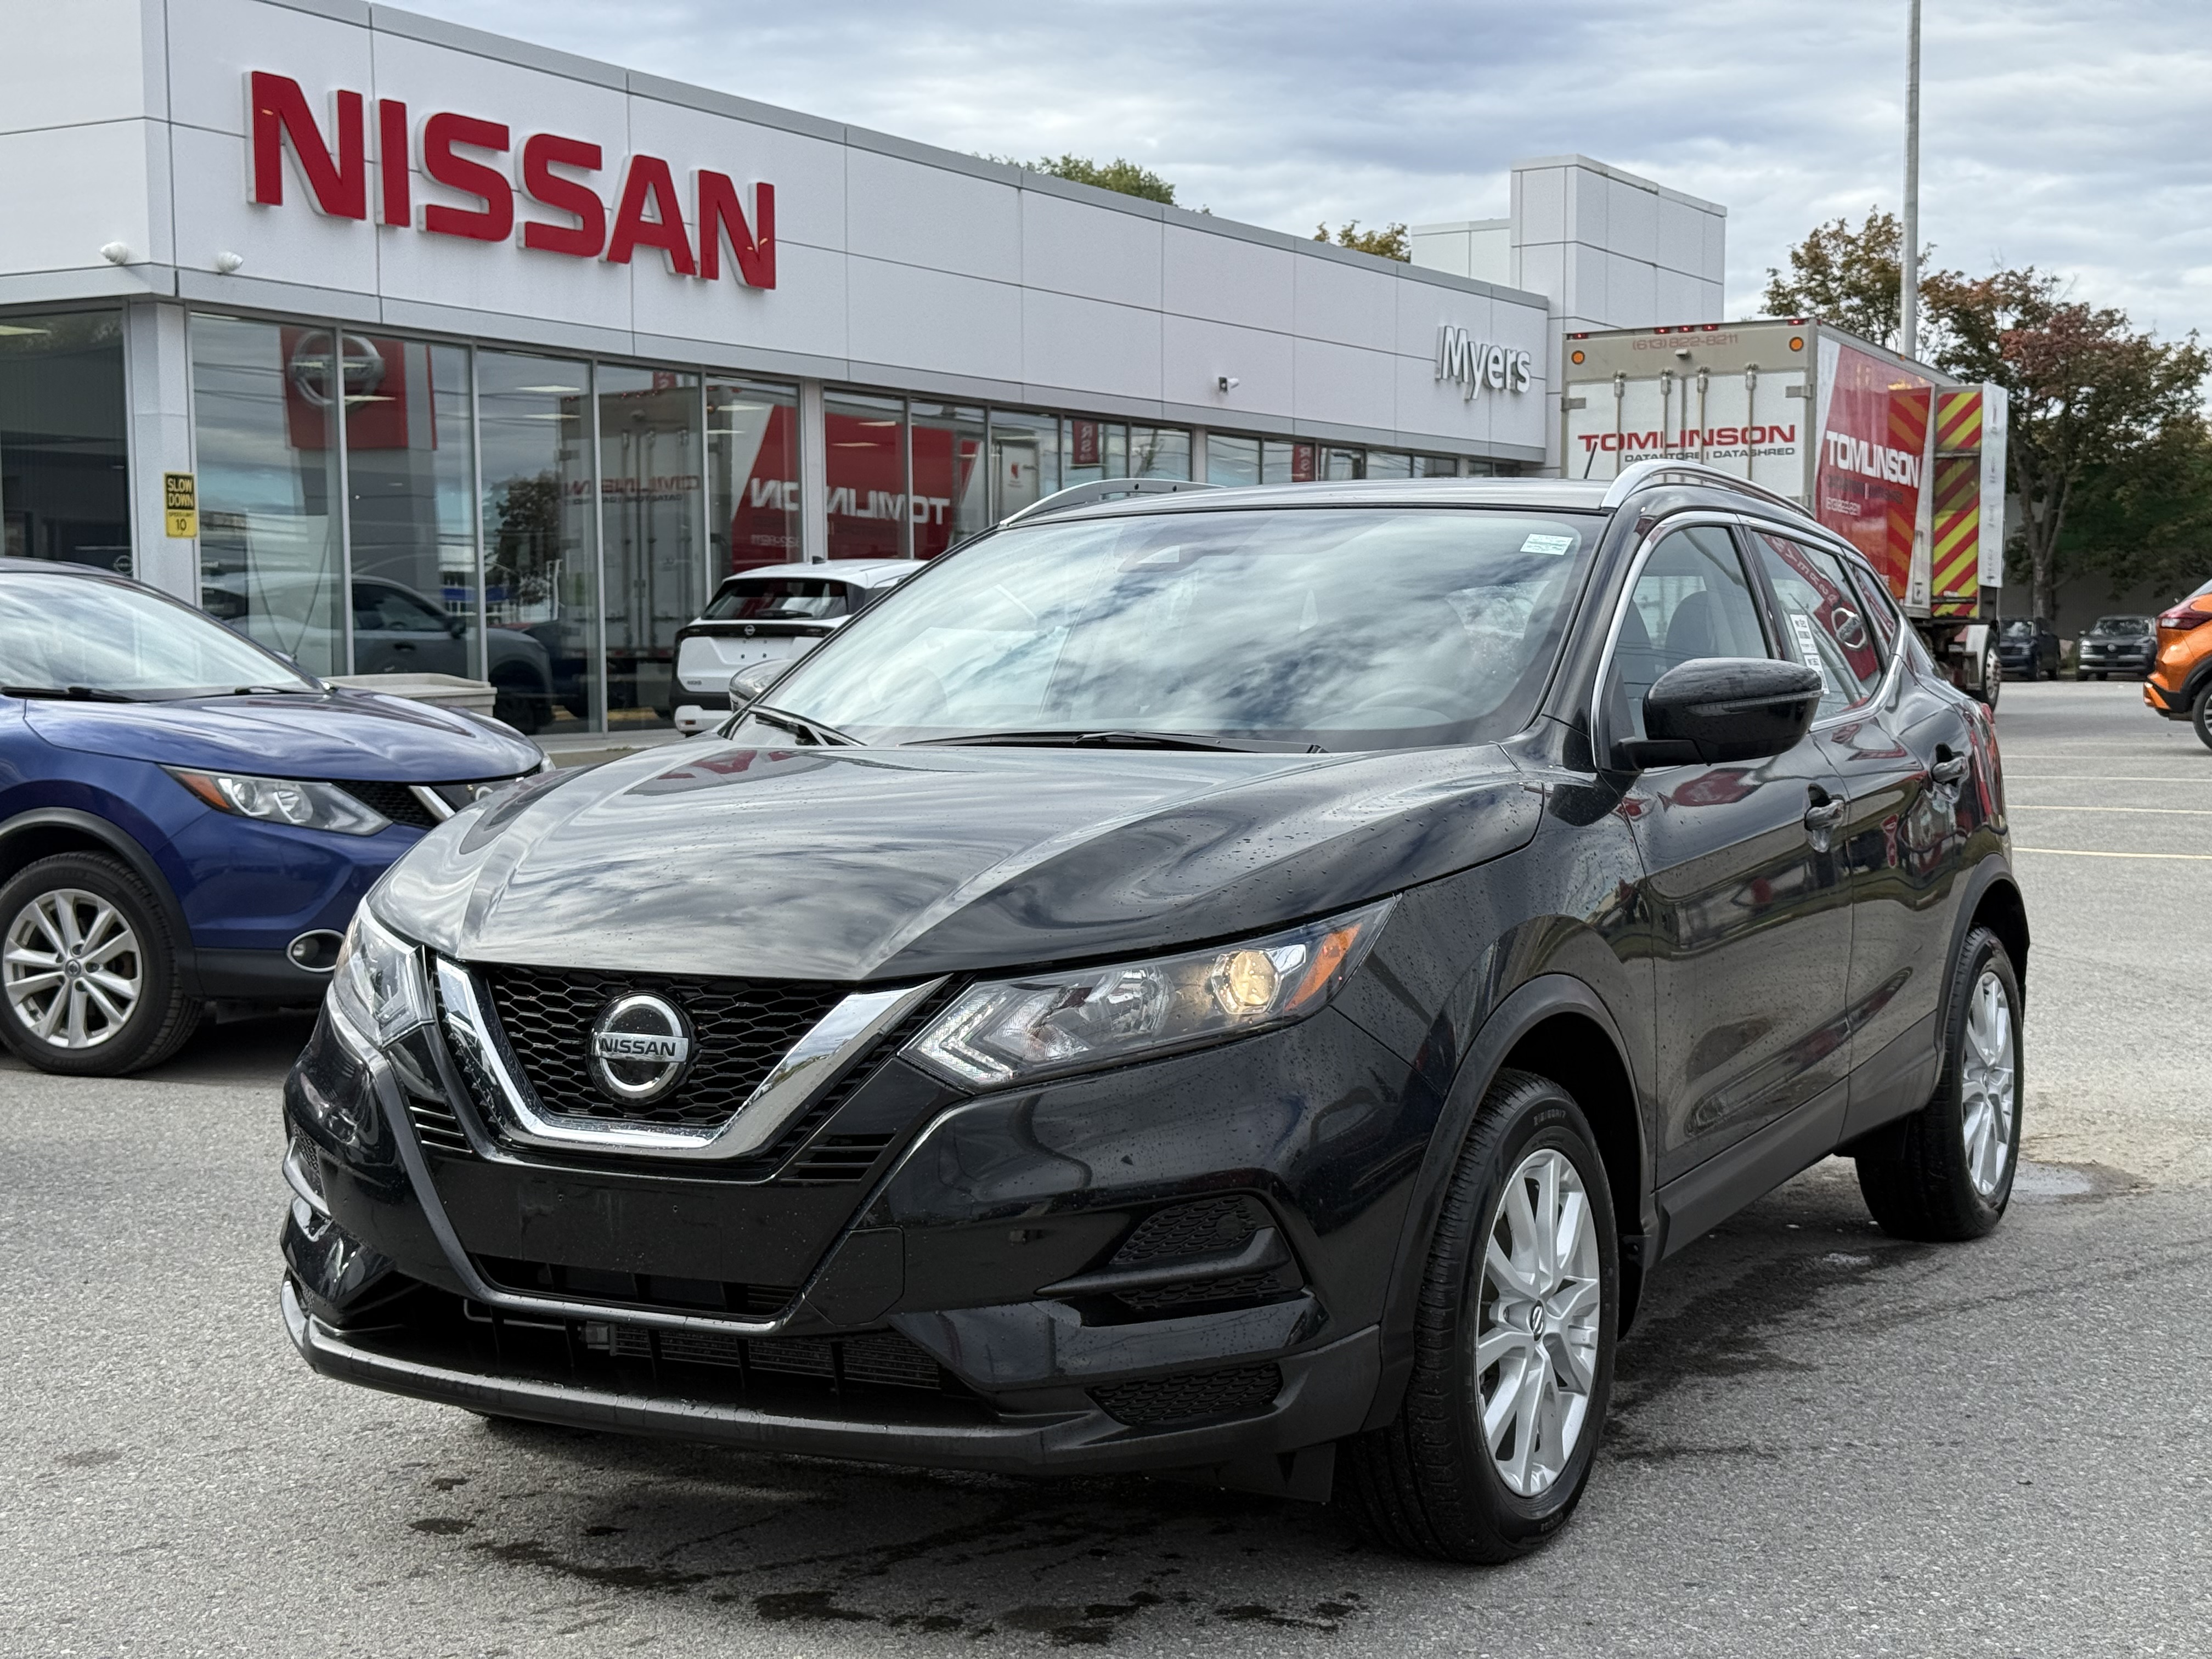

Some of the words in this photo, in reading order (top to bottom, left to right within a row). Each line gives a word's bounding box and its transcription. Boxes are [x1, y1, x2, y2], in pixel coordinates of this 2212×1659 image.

[246, 70, 777, 290] NISSAN
[1440, 325, 1532, 400] Myers
[1577, 424, 1796, 452] TOMLINSON
[1826, 430, 1919, 489] TOMLINSON
[167, 478, 193, 493] SLOW
[168, 493, 194, 507] DOWN
[176, 518, 187, 531] 10
[599, 1037, 676, 1057] NISSAN
